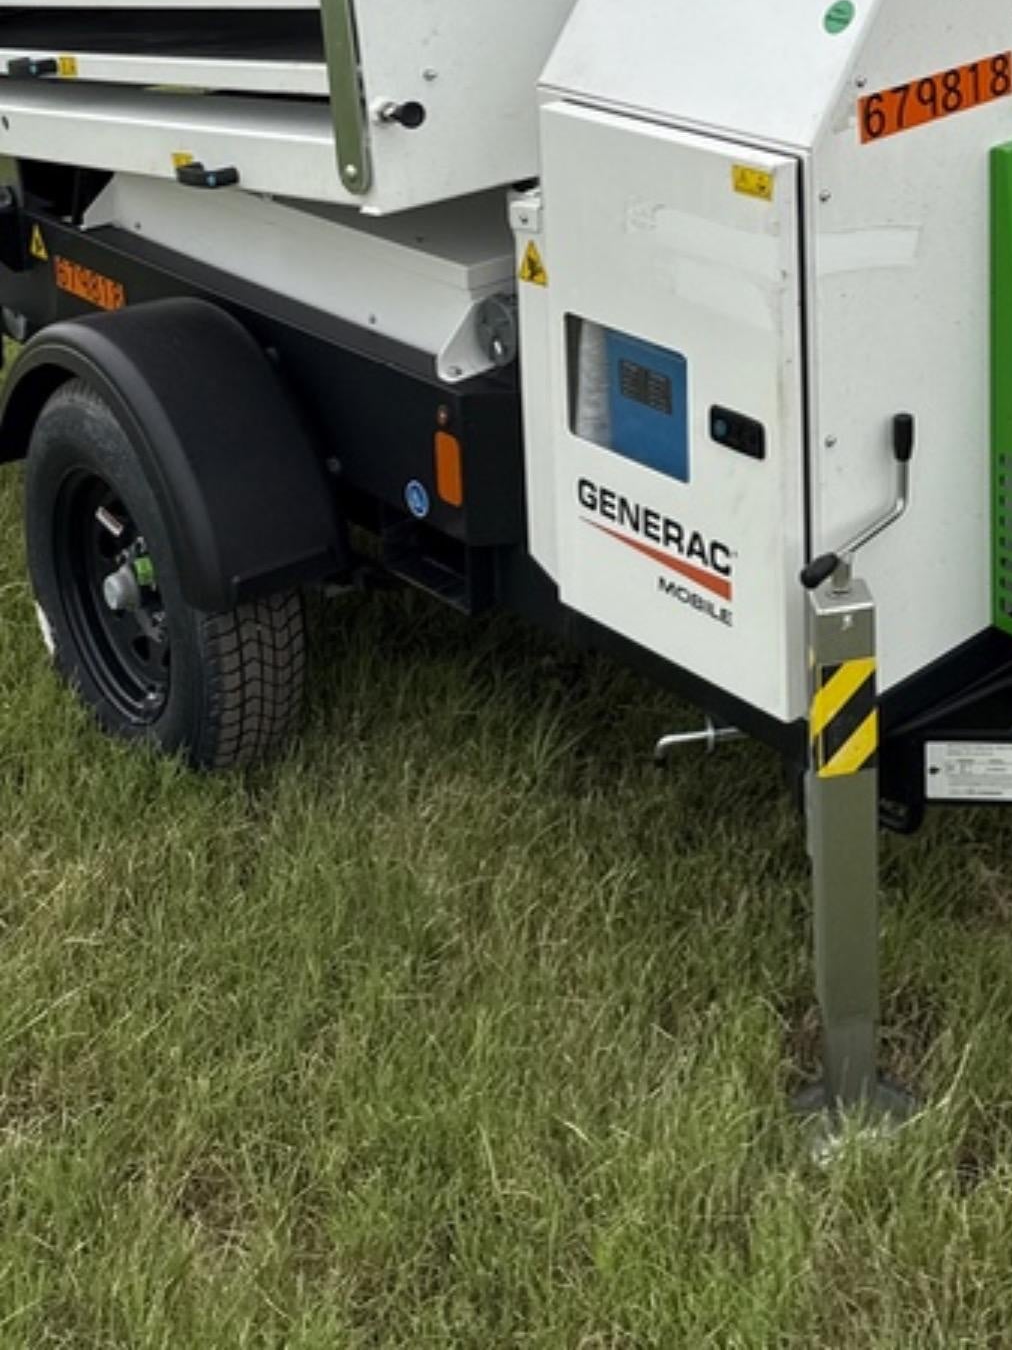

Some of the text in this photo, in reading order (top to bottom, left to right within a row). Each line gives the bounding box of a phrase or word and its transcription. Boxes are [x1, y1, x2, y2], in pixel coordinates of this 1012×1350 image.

[864, 53, 1012, 139] 679818
[577, 477, 732, 577] GENERAC
[657, 575, 733, 628] MOBILE
